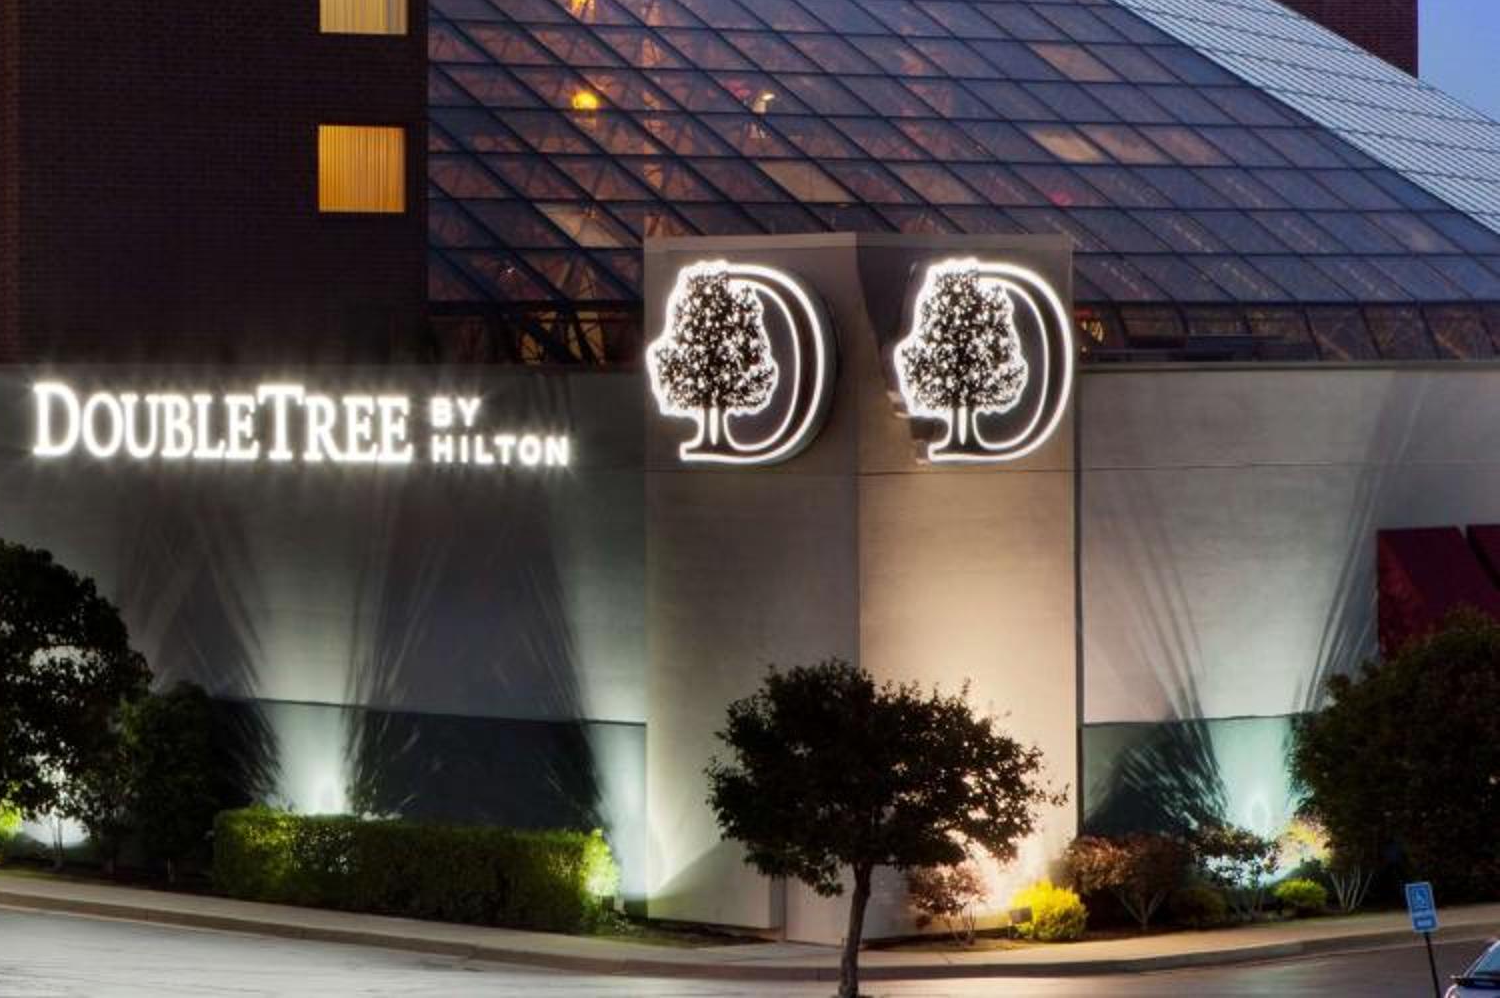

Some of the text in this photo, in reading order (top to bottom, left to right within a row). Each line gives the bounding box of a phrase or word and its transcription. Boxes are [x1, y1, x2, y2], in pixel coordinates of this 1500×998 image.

[32, 381, 414, 464] DOUBLETREE
[429, 396, 481, 428] BY
[430, 434, 571, 466] HILTON
